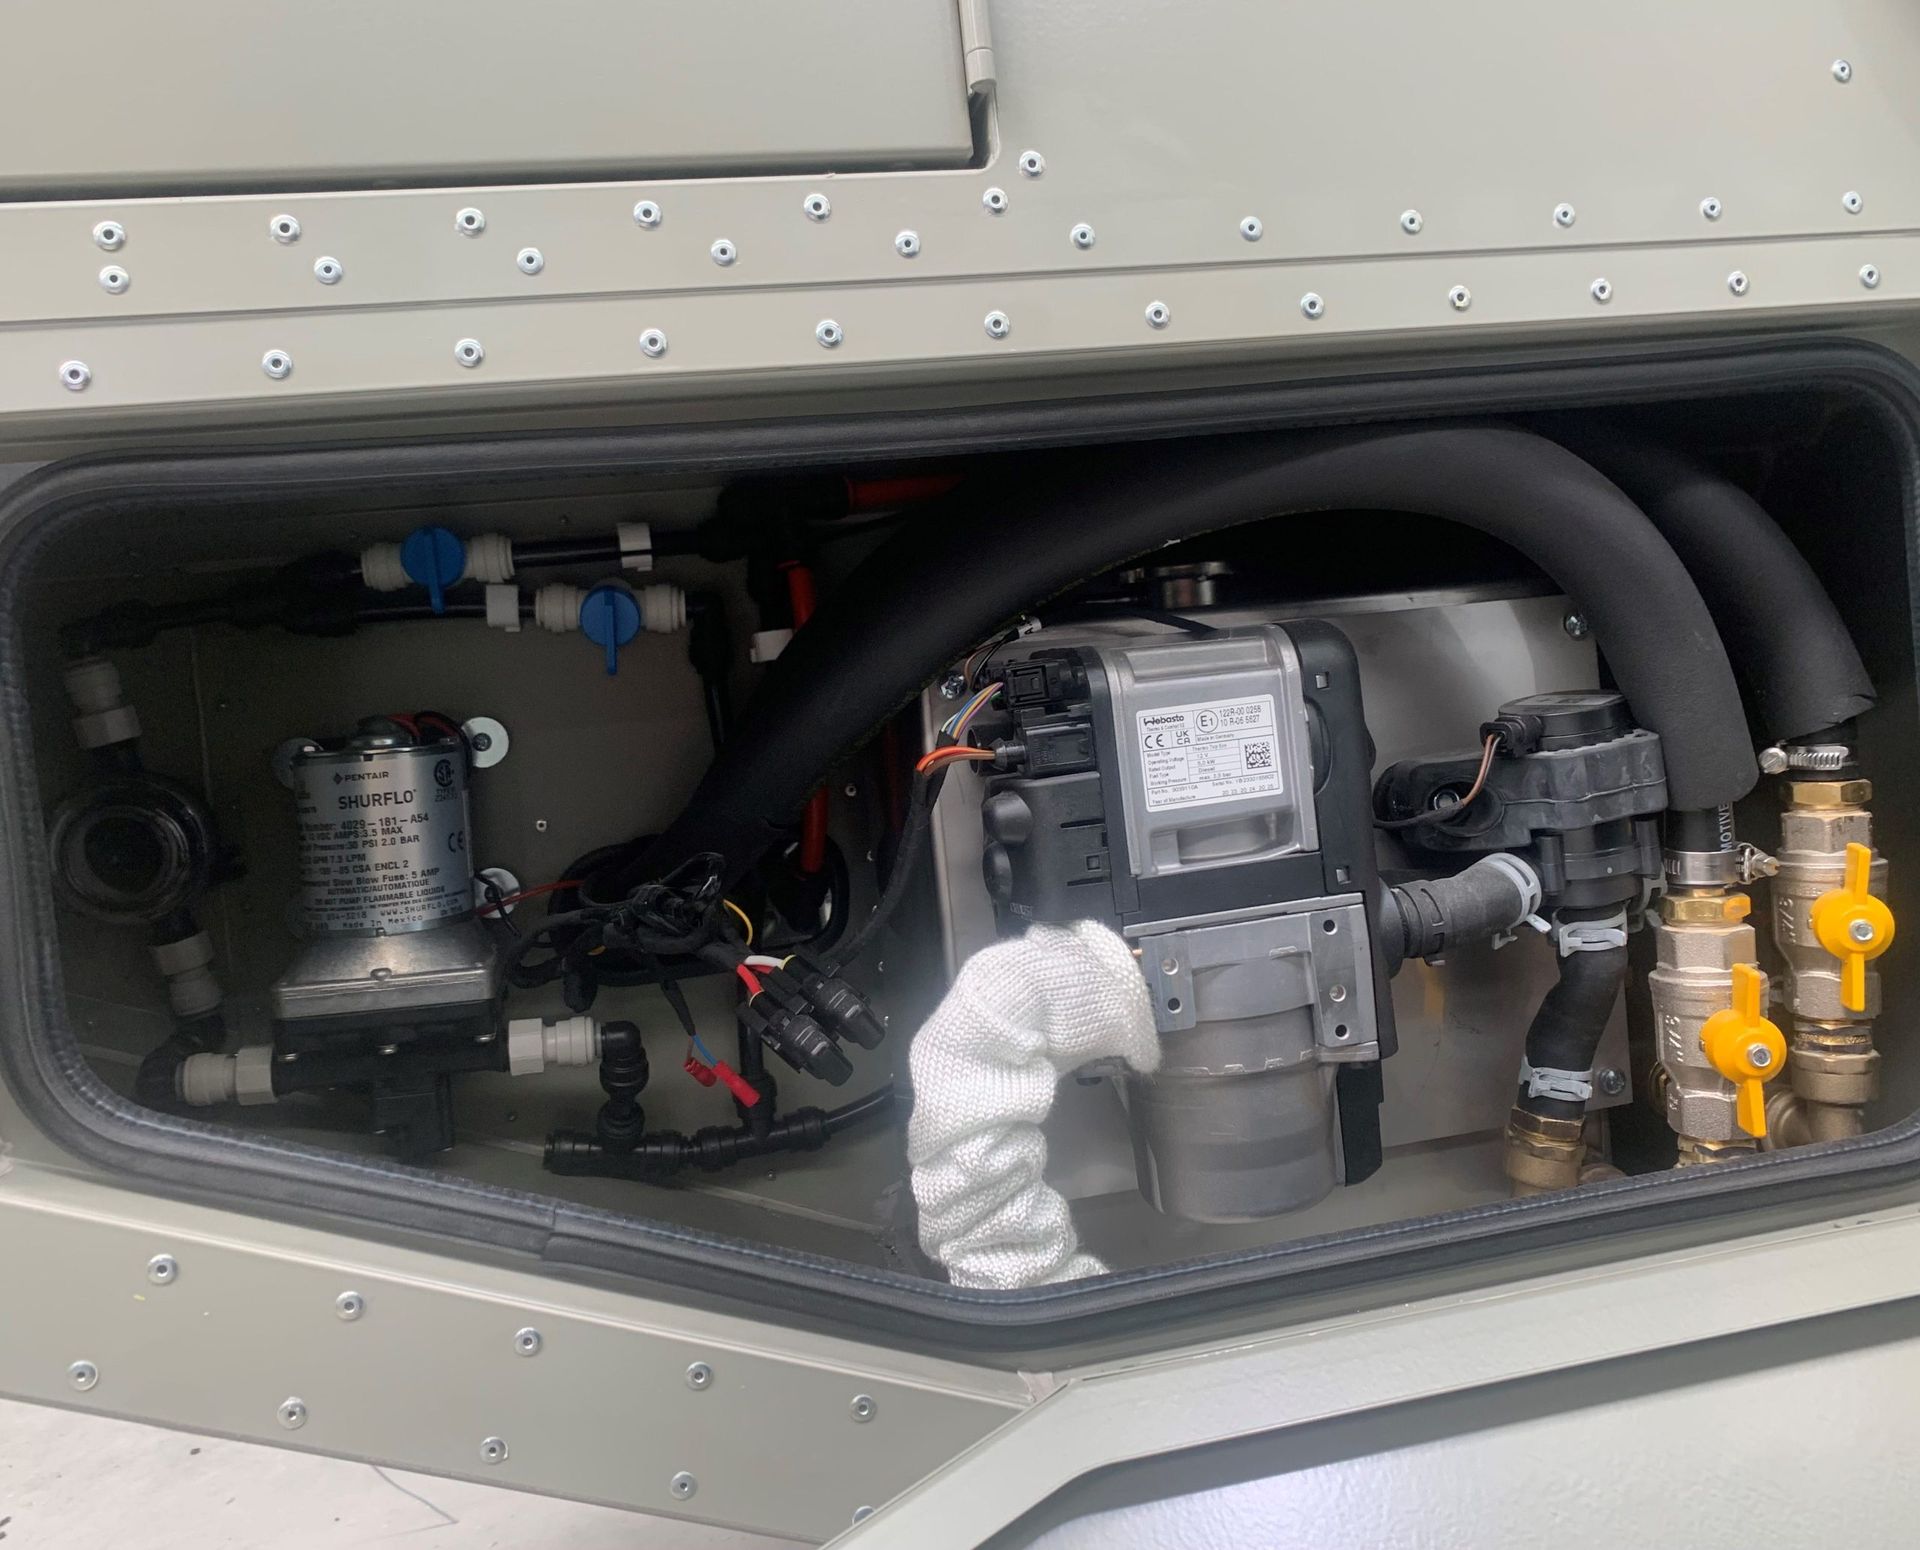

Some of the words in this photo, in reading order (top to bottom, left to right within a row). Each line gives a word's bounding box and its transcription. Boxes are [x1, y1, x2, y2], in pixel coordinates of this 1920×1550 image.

[1143, 713, 1185, 727] Webasto
[345, 771, 390, 782] PENTAIR
[338, 790, 414, 810] SHURFLO
